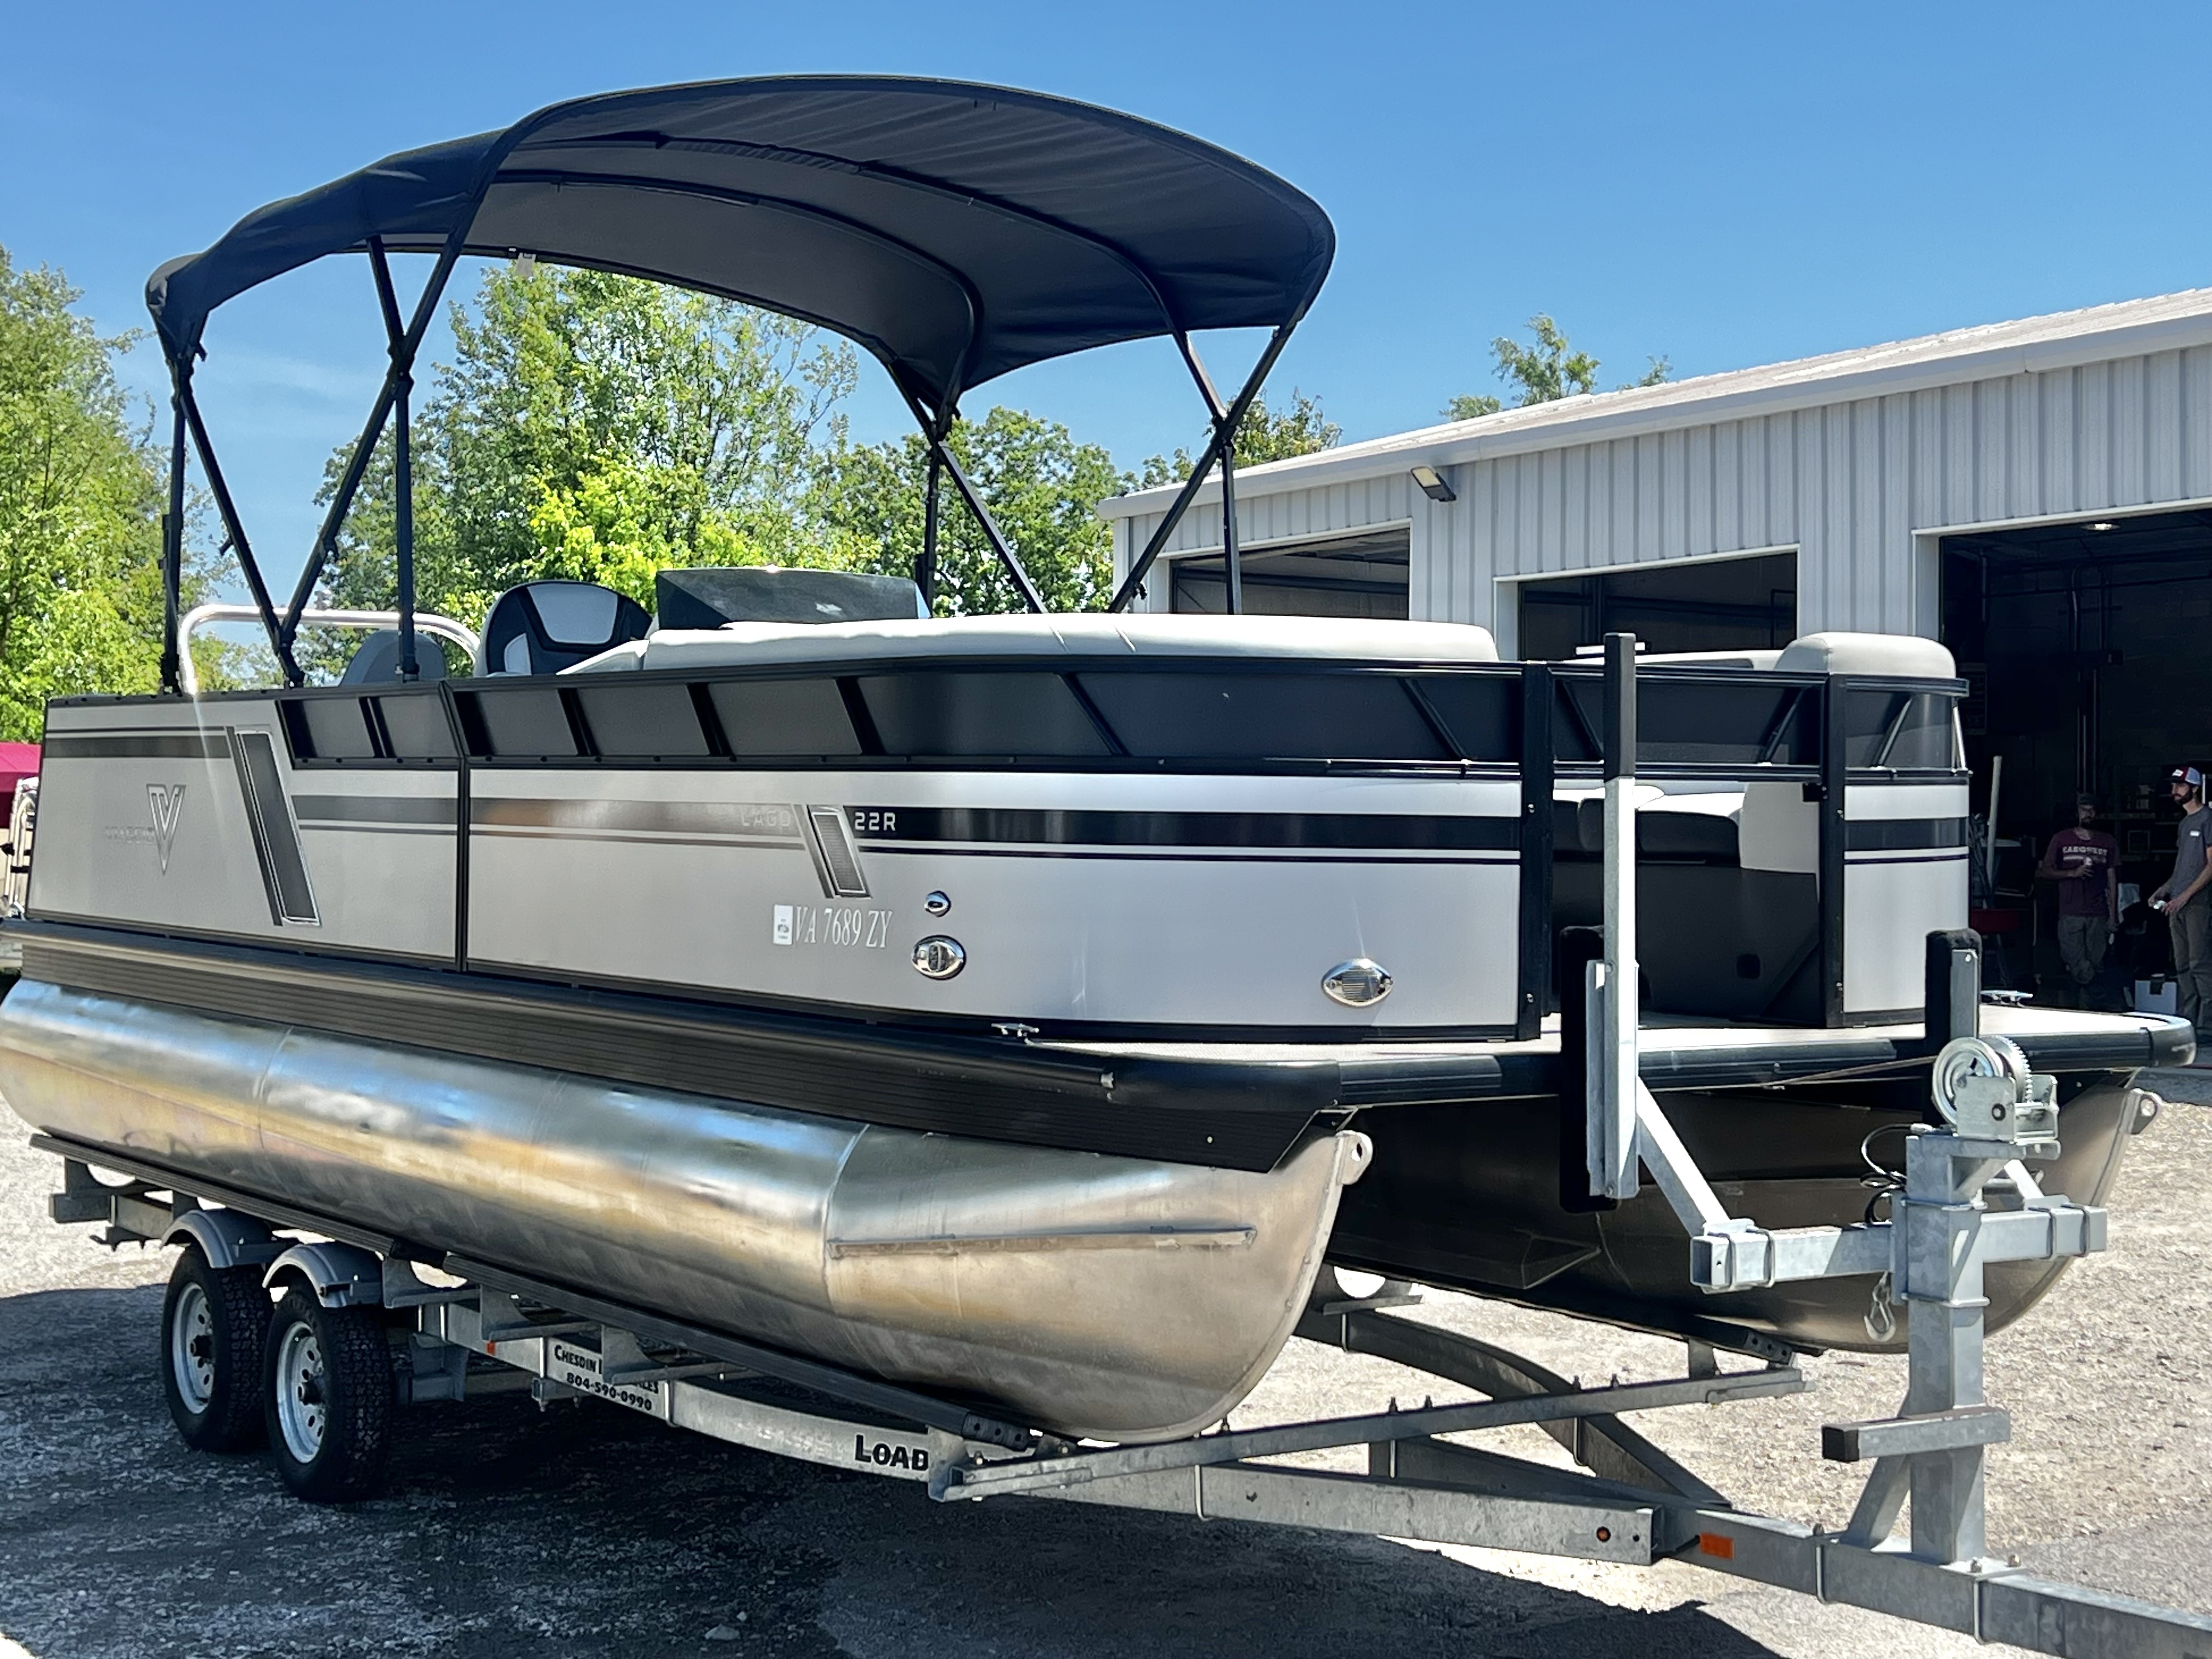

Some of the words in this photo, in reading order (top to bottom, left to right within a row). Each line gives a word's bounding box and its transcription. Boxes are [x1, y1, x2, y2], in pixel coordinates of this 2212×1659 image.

[855, 812, 896, 831] 22R
[795, 906, 817, 944] VA
[823, 908, 862, 946] 7689
[866, 910, 893, 948] ZY
[554, 1344, 597, 1373] CHESDIN
[567, 1372, 652, 1411] 804-590-0990
[855, 1434, 929, 1471] LOAD
